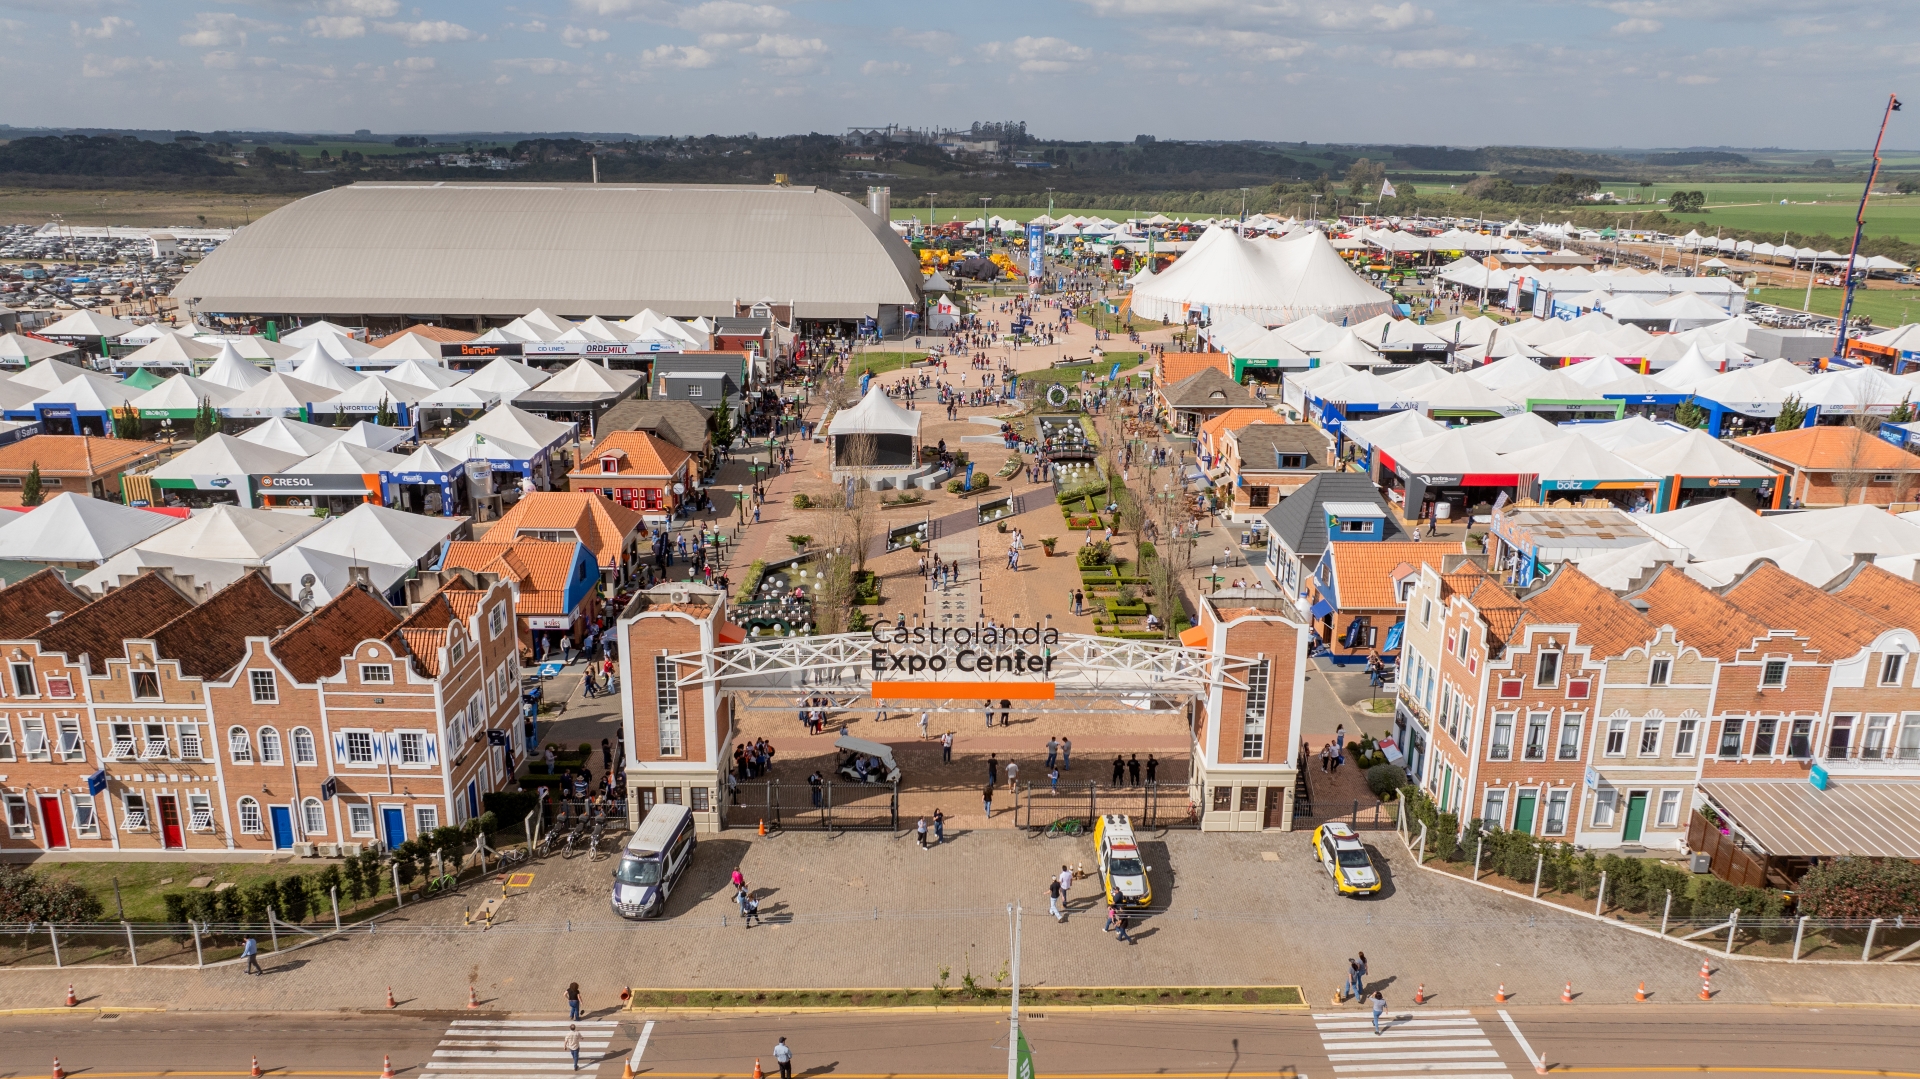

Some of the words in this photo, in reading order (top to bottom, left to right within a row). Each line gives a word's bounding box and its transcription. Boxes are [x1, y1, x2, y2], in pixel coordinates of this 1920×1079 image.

[21, 426, 38, 438] Safra
[273, 478, 313, 486] CRESOL
[872, 619, 1059, 645] Castrolanda
[871, 649, 947, 675] Expo
[956, 649, 1058, 673] Center
